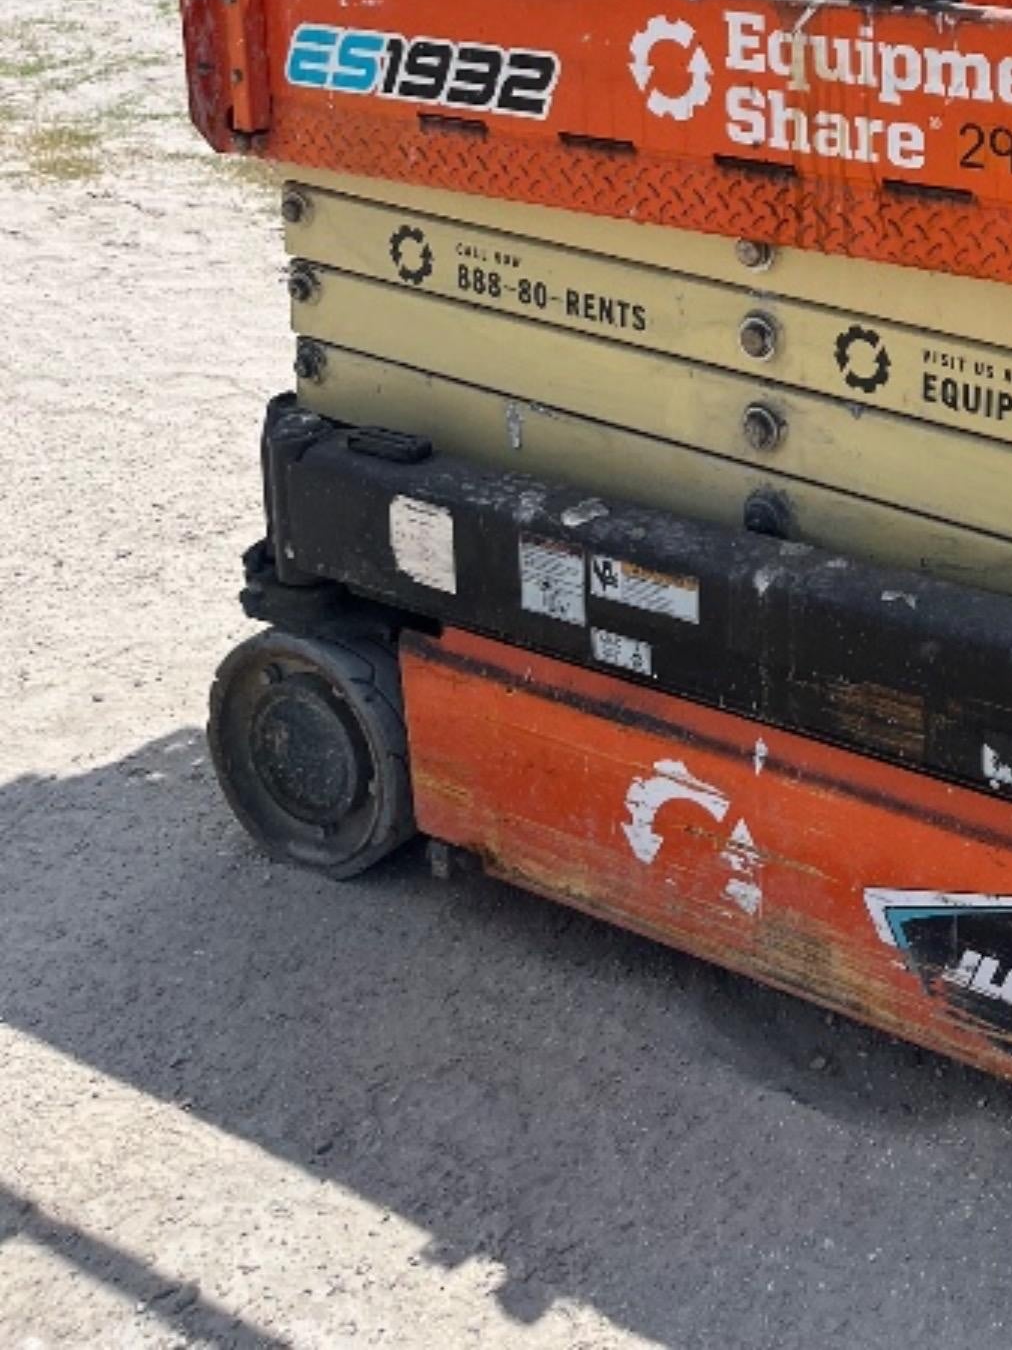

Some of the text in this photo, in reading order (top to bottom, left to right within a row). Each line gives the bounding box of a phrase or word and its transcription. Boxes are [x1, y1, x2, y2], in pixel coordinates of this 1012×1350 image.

[287, 25, 559, 118] ES1932
[724, 85, 926, 170] Share
[494, 251, 522, 268] NOW
[457, 263, 647, 332] 888-80-RENTS
[922, 349, 966, 372] VISIT
[974, 361, 995, 379] US
